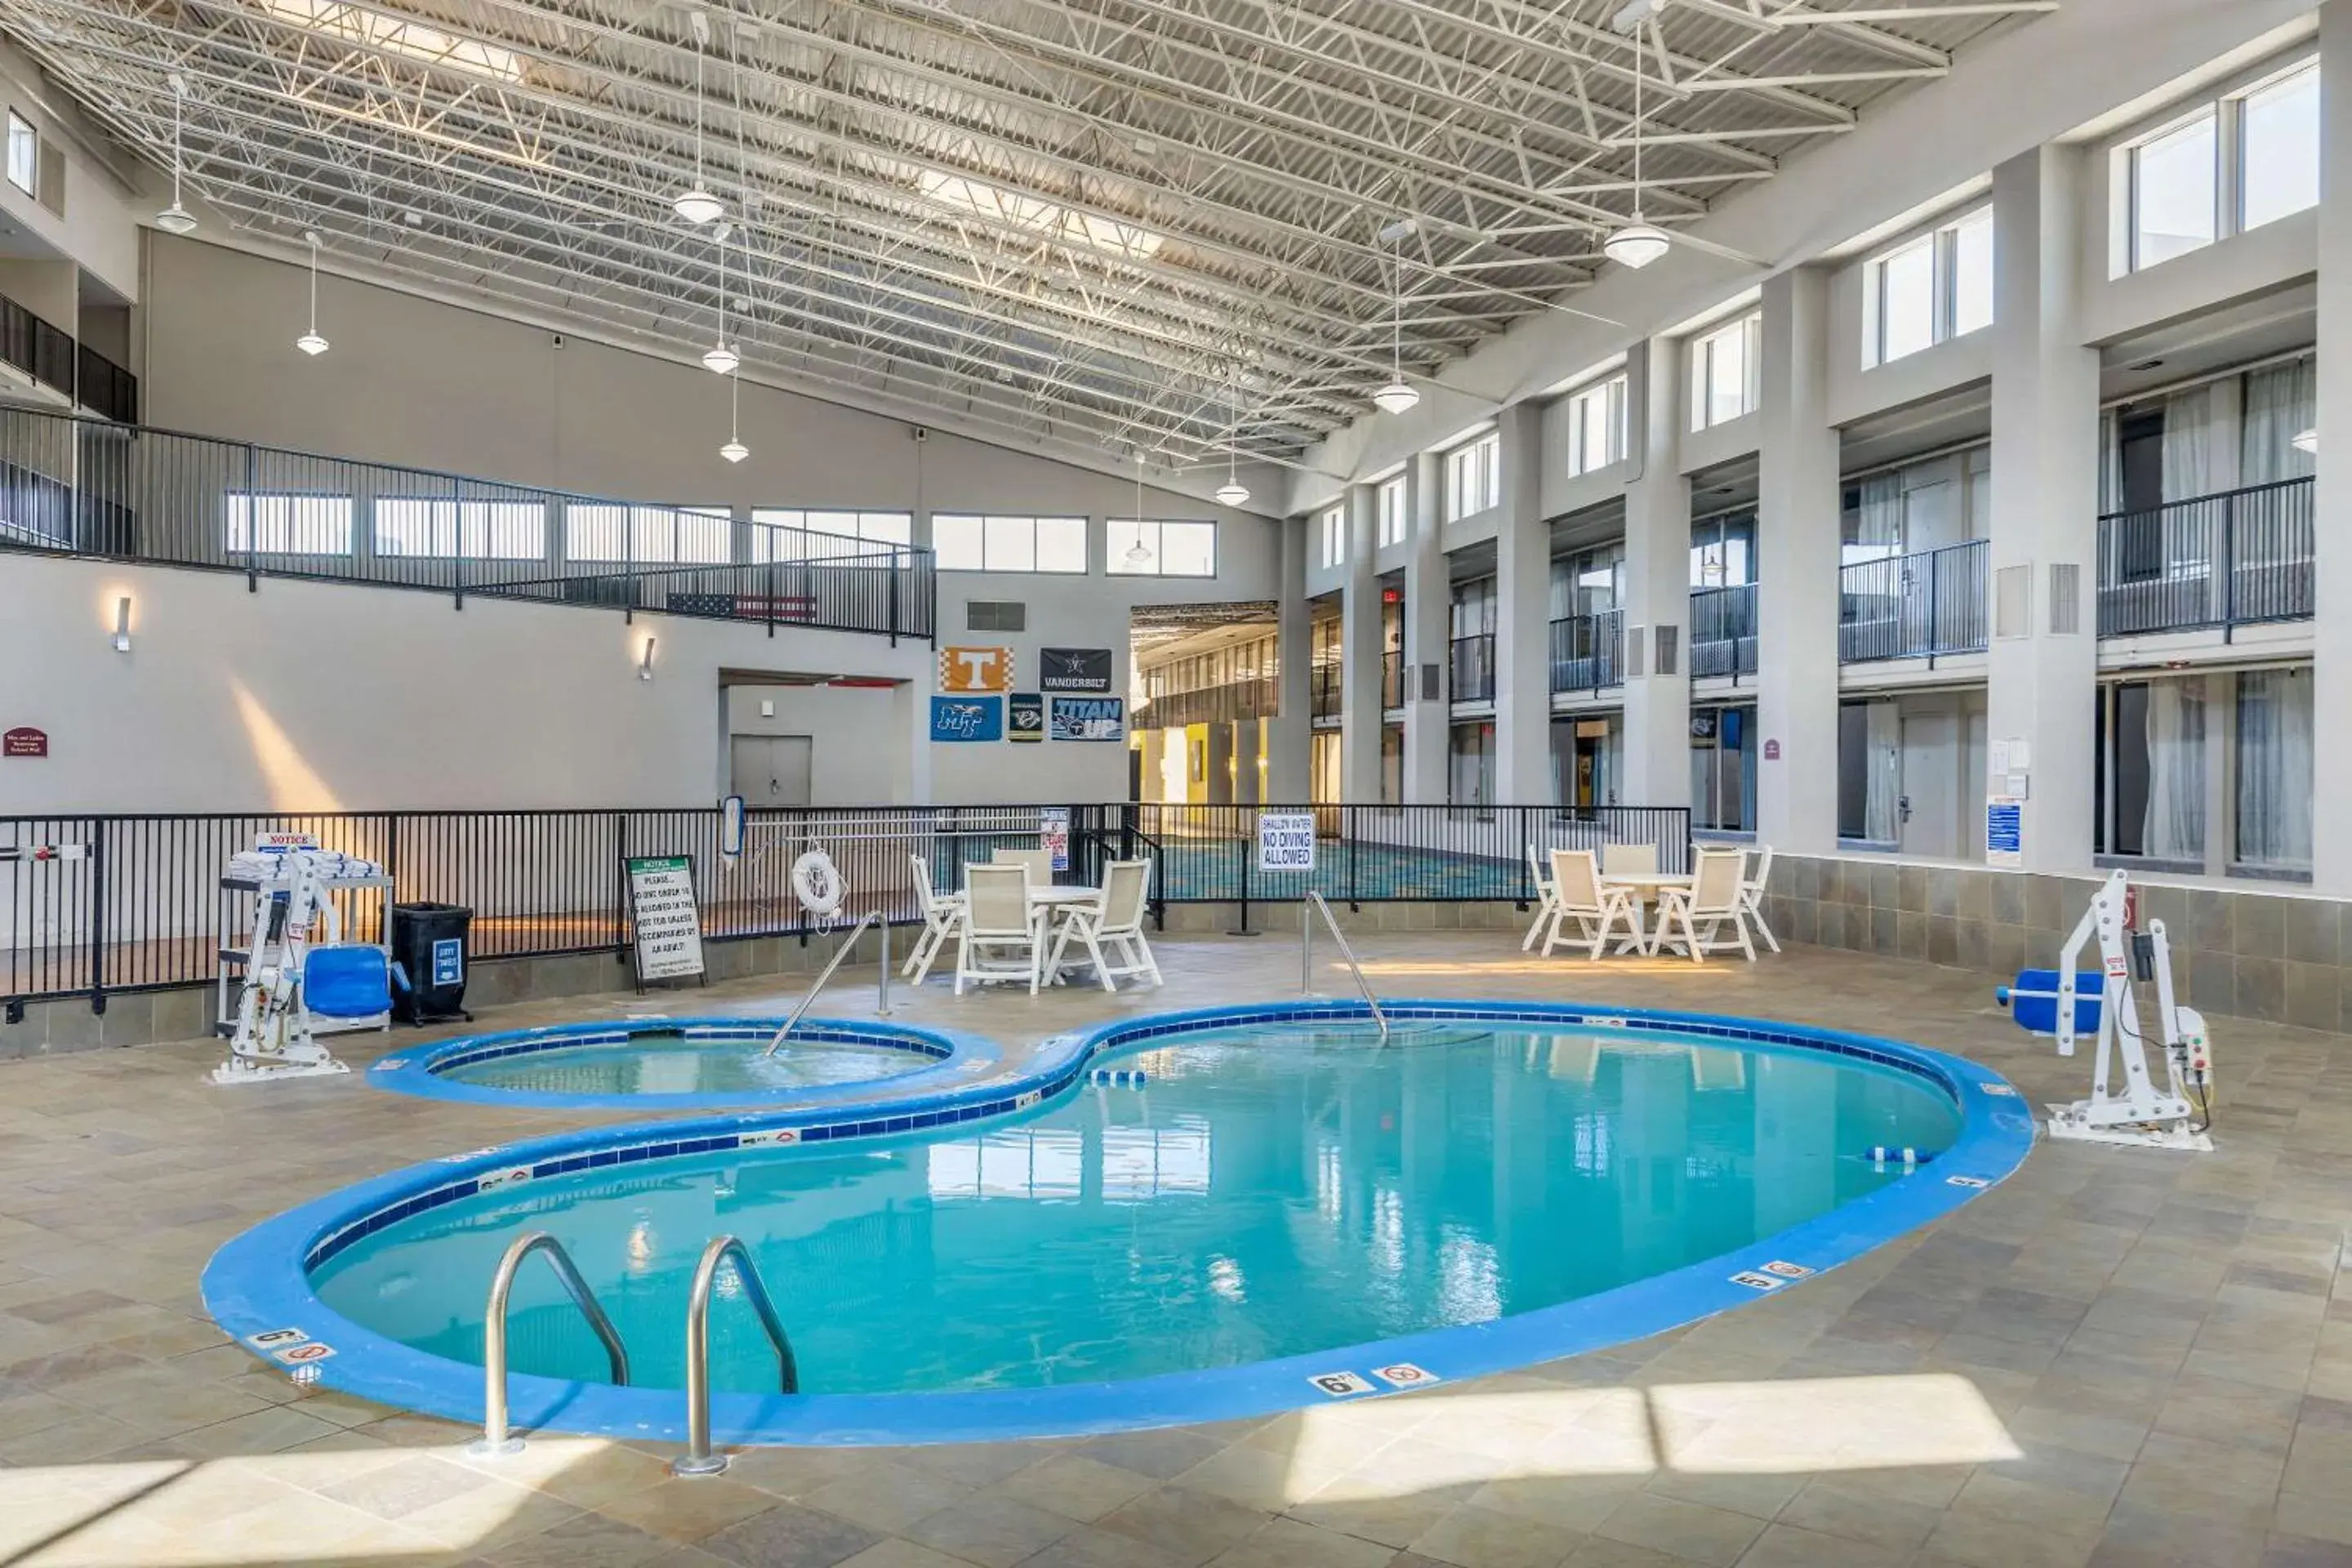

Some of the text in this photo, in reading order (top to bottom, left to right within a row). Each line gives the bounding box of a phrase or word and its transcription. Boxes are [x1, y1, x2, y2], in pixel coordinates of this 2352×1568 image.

[958, 652, 996, 690] T
[1045, 677, 1107, 688] VANDERBILT
[1055, 699, 1121, 719] TITAN
[1083, 719, 1118, 738] UP
[270, 835, 308, 844] NOTICE
[1263, 832, 1311, 848] NO DIVING
[1264, 849, 1310, 865] ALLOWED
[1316, 1378, 1352, 1393] 6
